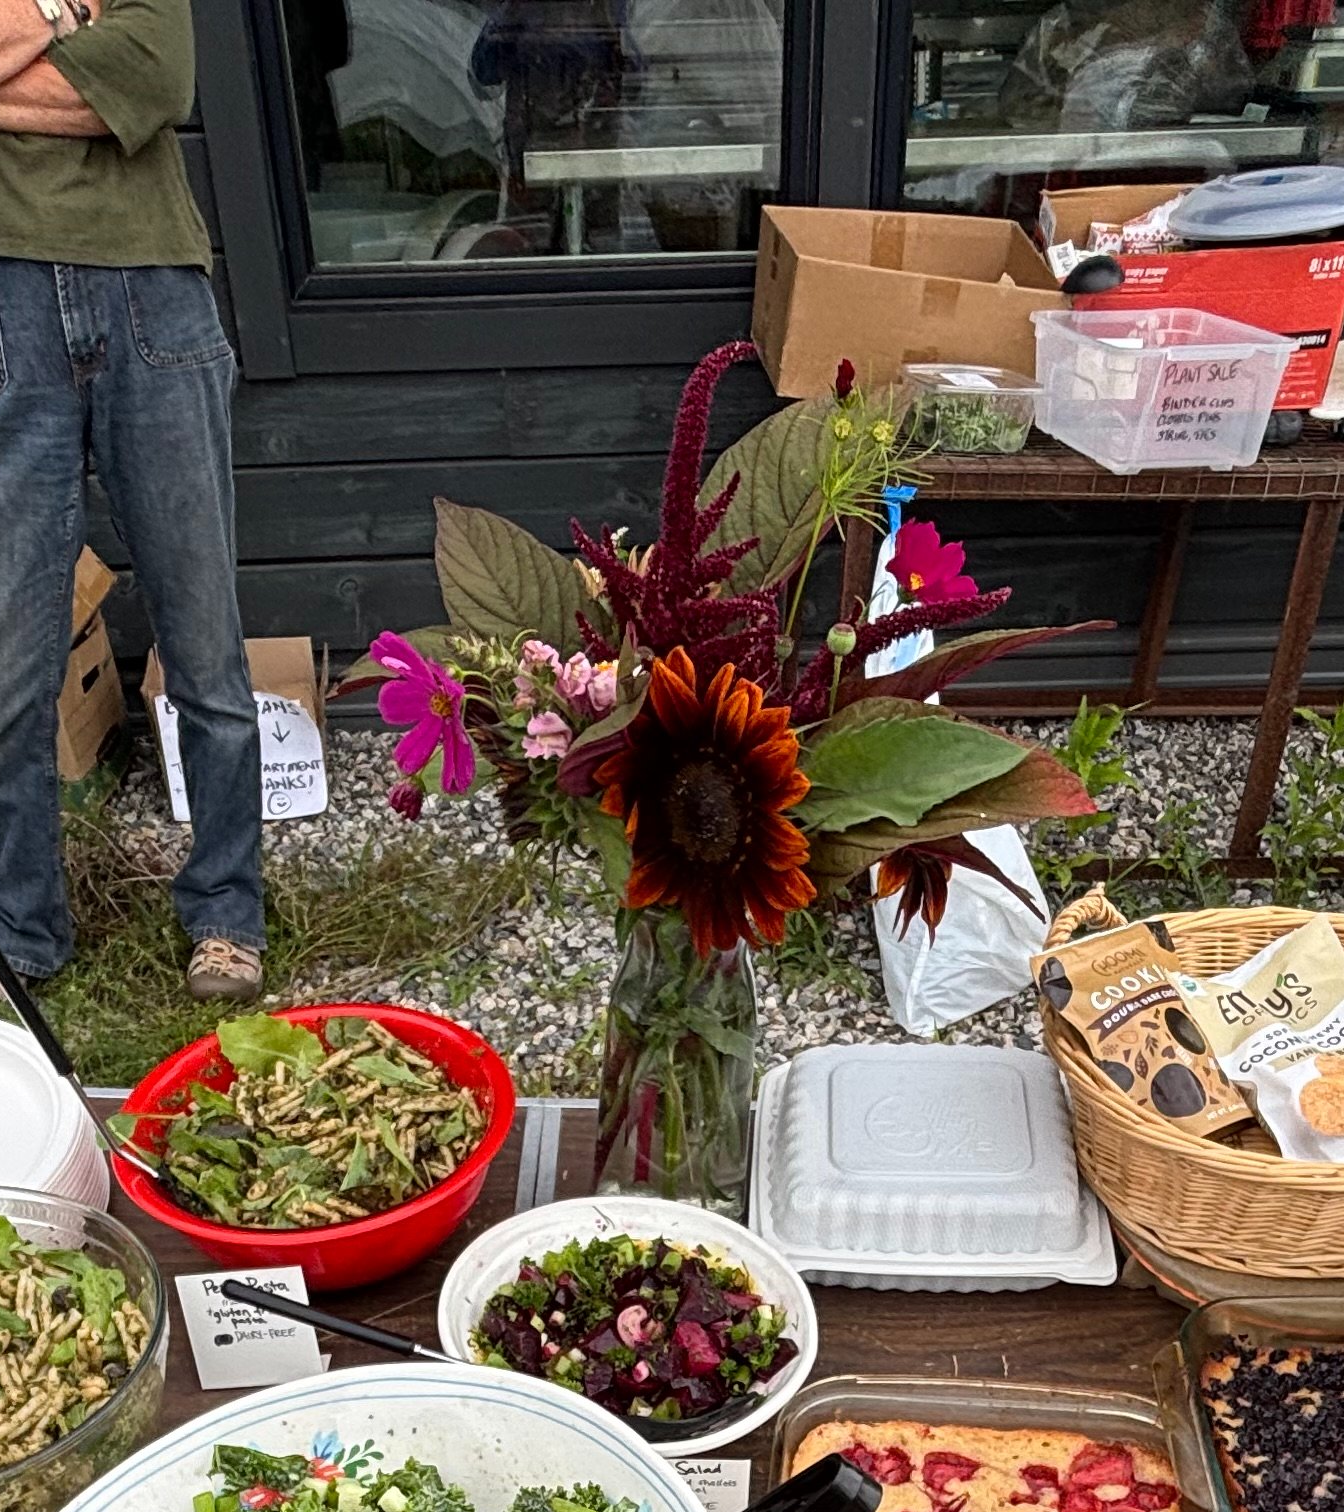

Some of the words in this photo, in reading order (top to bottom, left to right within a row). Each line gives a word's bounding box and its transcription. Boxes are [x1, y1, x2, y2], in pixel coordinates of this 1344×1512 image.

[1164, 362, 1206, 387] PLANT
[1207, 359, 1243, 382] SALE
[256, 700, 300, 716] ANS
[262, 760, 322, 774] ARTMENT
[264, 775, 313, 792] ANKS!
[1090, 963, 1167, 1010] COOKI
[1265, 1027, 1289, 1041] SOF
[1239, 1034, 1303, 1073] COCON
[675, 1460, 722, 1475] Salad
